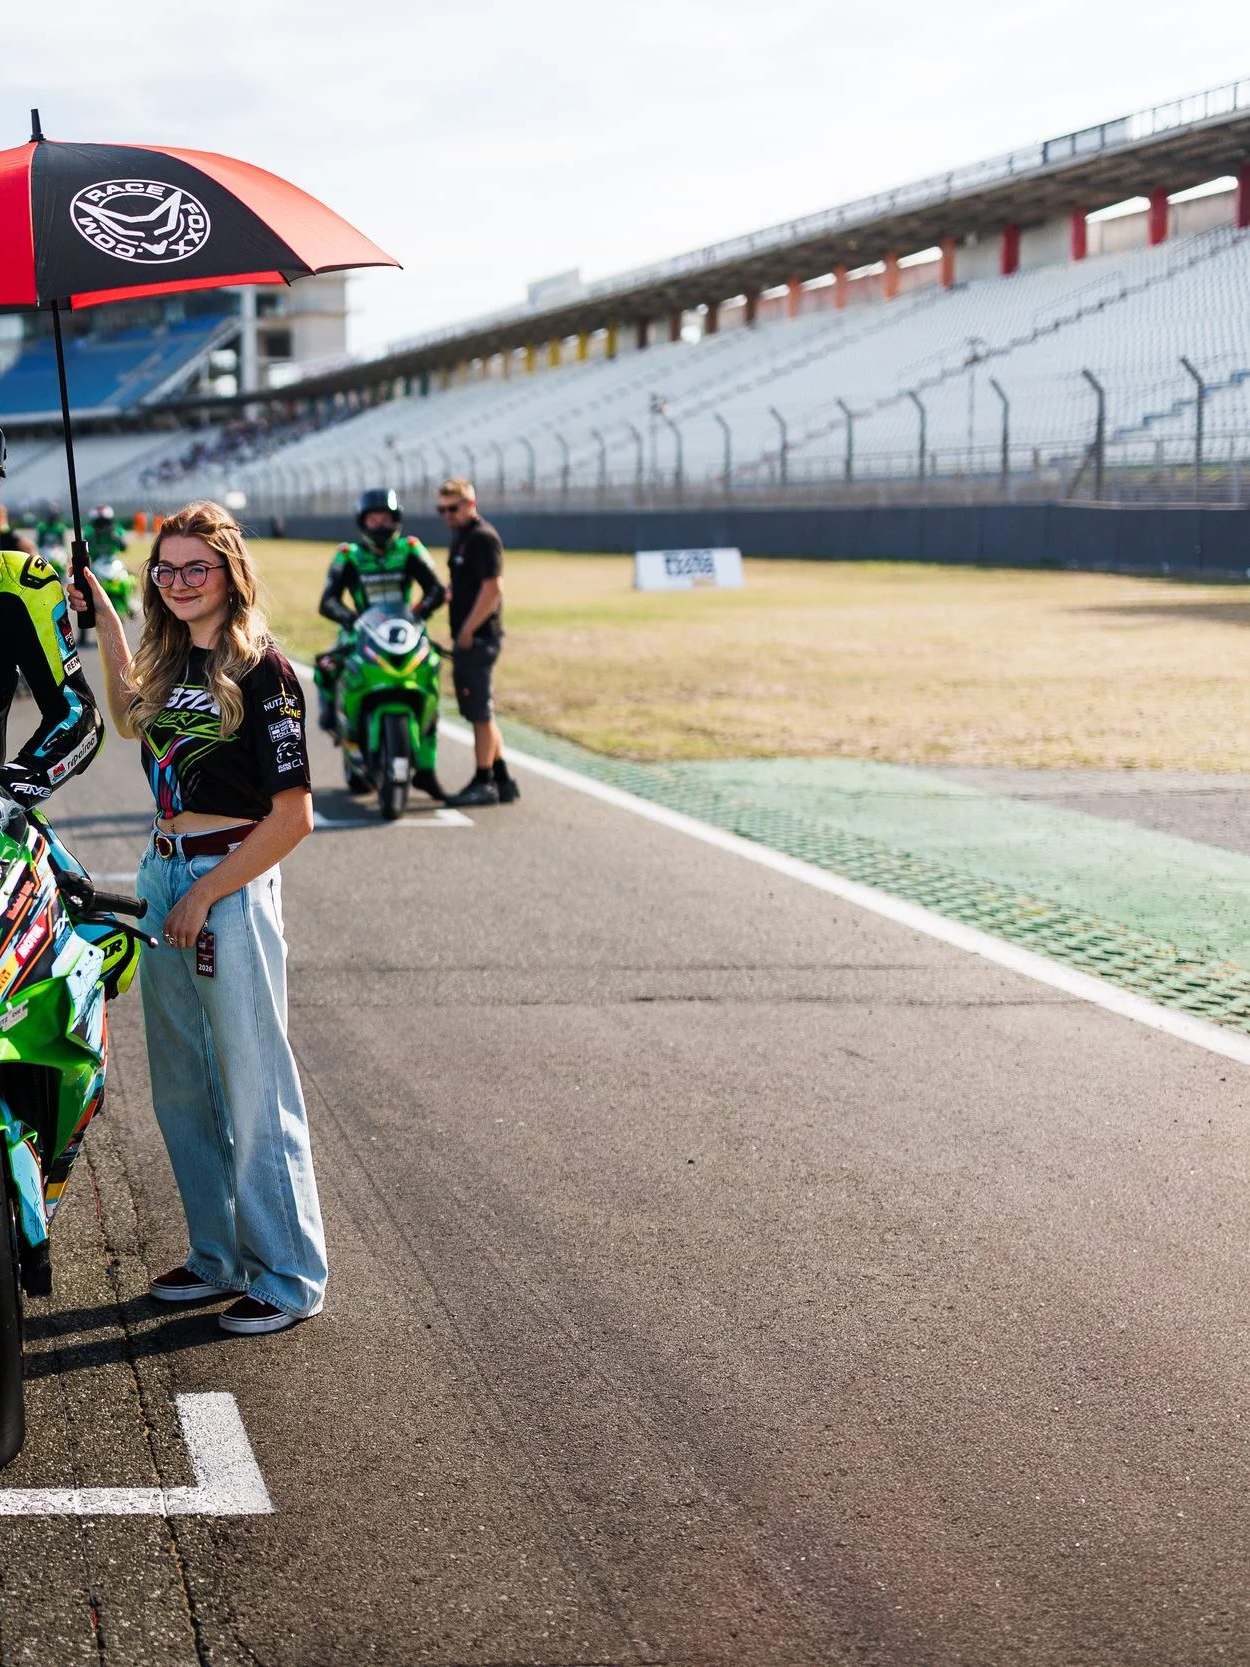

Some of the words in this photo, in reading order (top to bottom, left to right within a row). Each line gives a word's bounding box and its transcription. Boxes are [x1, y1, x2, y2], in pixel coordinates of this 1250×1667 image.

[84, 182, 166, 202] RACE
[168, 202, 205, 256] FOXX
[263, 697, 283, 712] NUTZ
[10, 782, 51, 798] FIVE
[198, 963, 213, 973] 2026
